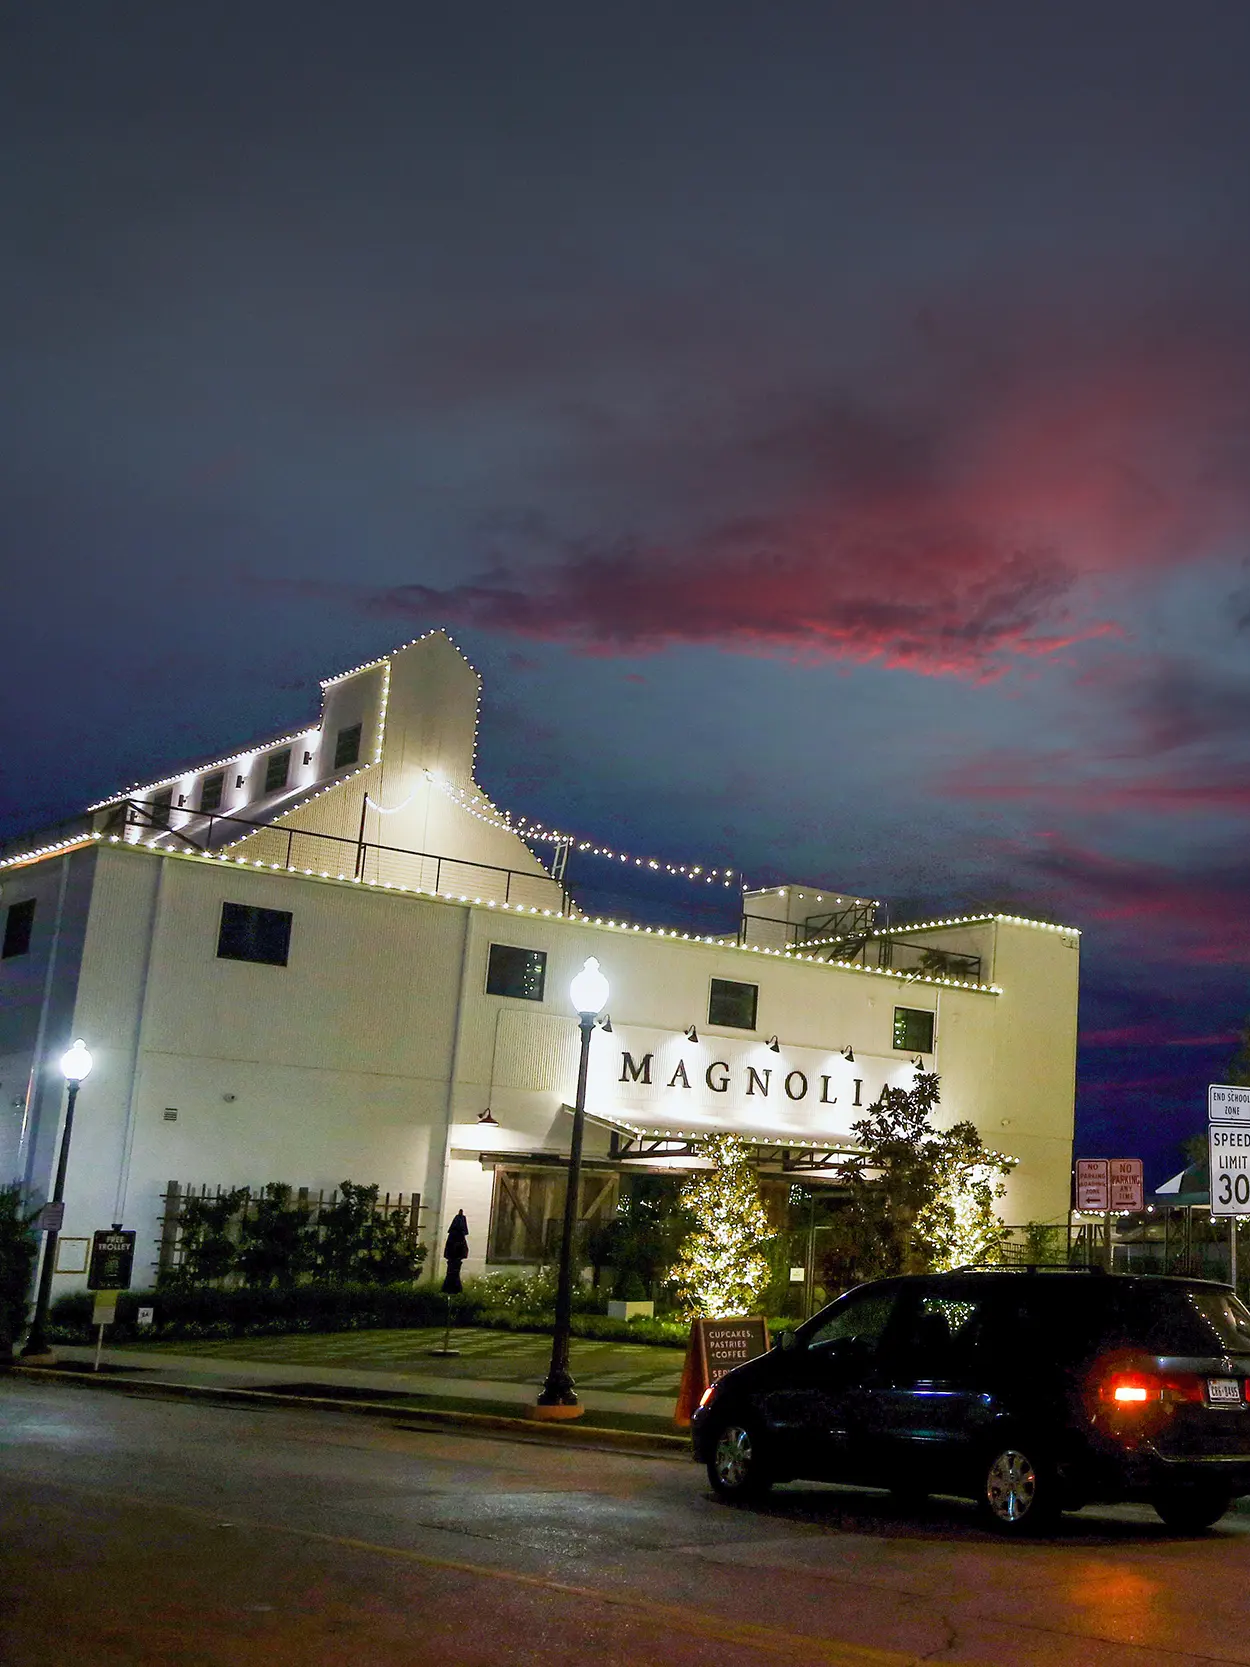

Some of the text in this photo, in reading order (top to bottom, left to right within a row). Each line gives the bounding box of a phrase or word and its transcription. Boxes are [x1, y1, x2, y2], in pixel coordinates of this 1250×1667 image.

[1213, 1092, 1250, 1103] END SCHOOL
[1224, 1106, 1240, 1116] ZONE
[1219, 1155, 1248, 1169] LIMIT
[1119, 1163, 1132, 1173] NO
[1112, 1174, 1140, 1185] PARKING
[1218, 1173, 1250, 1205] 30
[106, 1235, 125, 1243] FREE
[98, 1243, 131, 1251] TROLLEY
[708, 1330, 754, 1339] CUPCAKES,
[710, 1340, 747, 1349] PASTRIES
